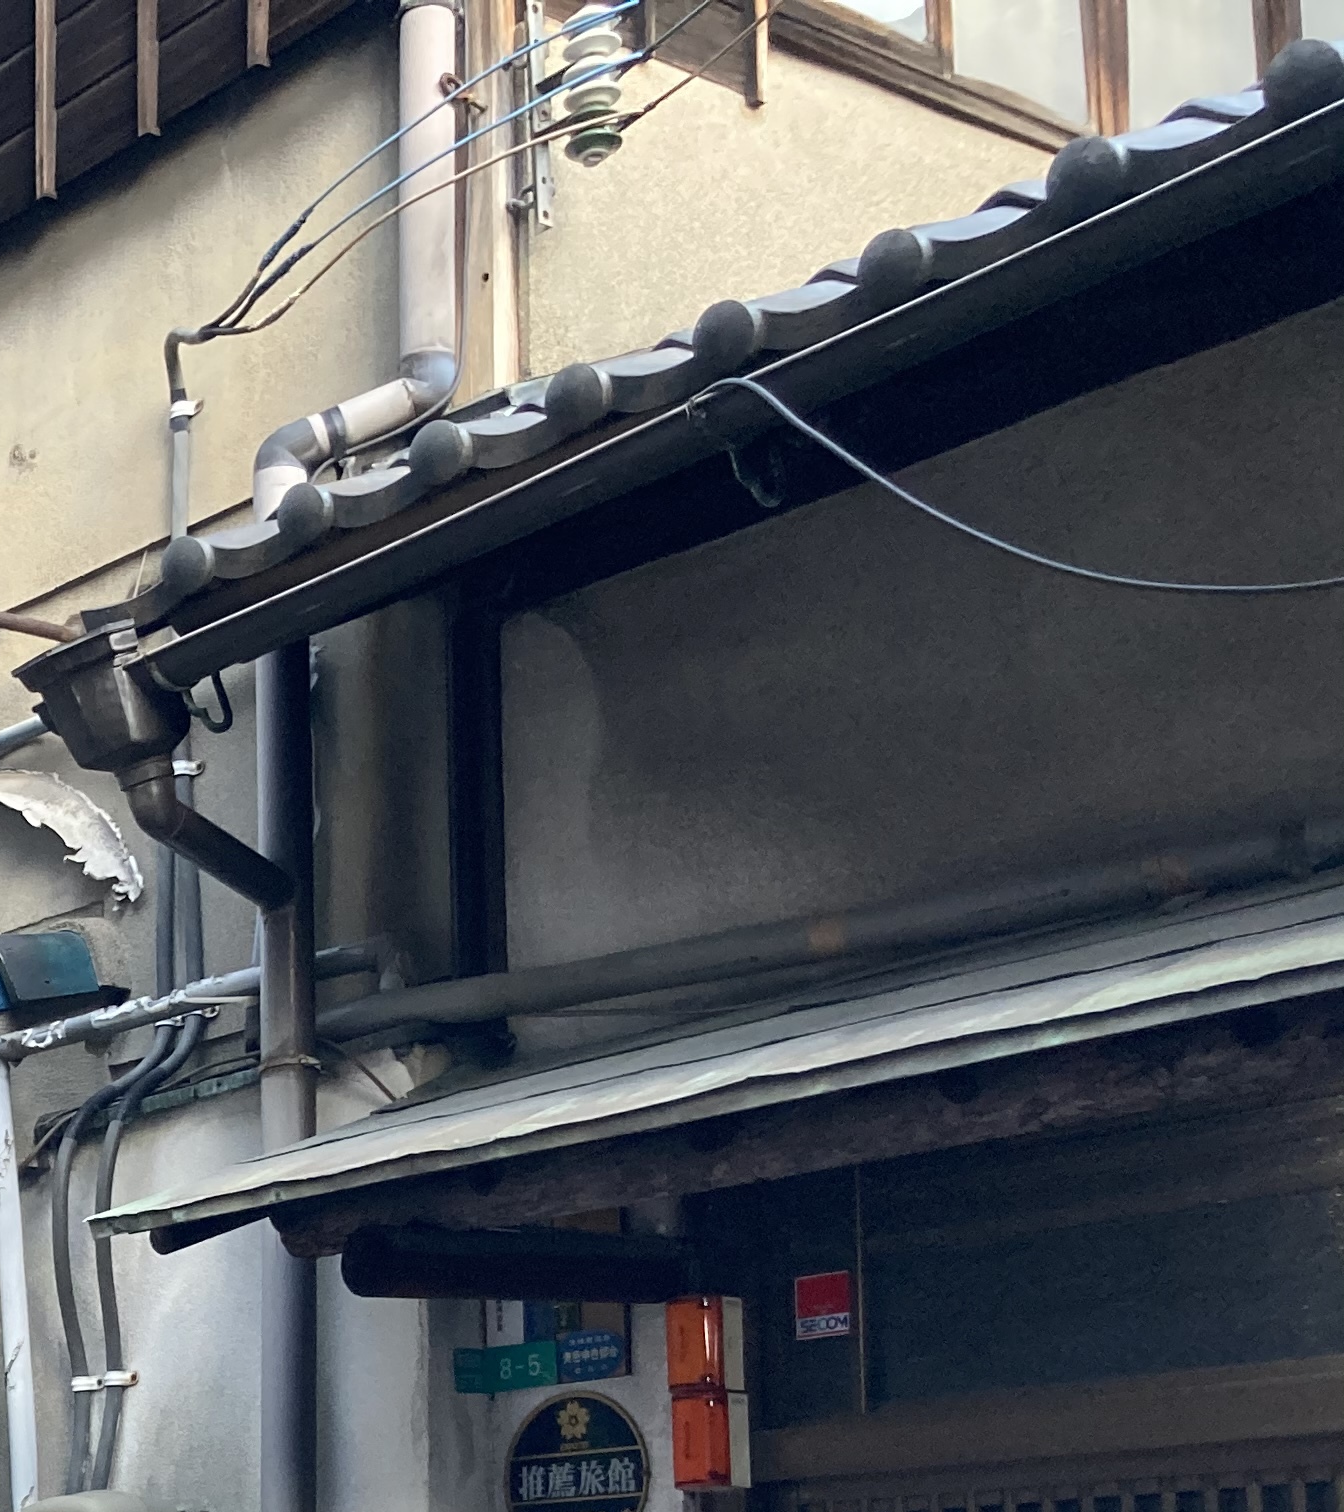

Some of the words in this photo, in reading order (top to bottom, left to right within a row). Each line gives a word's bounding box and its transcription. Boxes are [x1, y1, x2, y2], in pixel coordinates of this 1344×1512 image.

[799, 1315, 848, 1333] SECOM
[499, 1353, 542, 1380] 8-5
[518, 1456, 636, 1501] 推薦旅館
